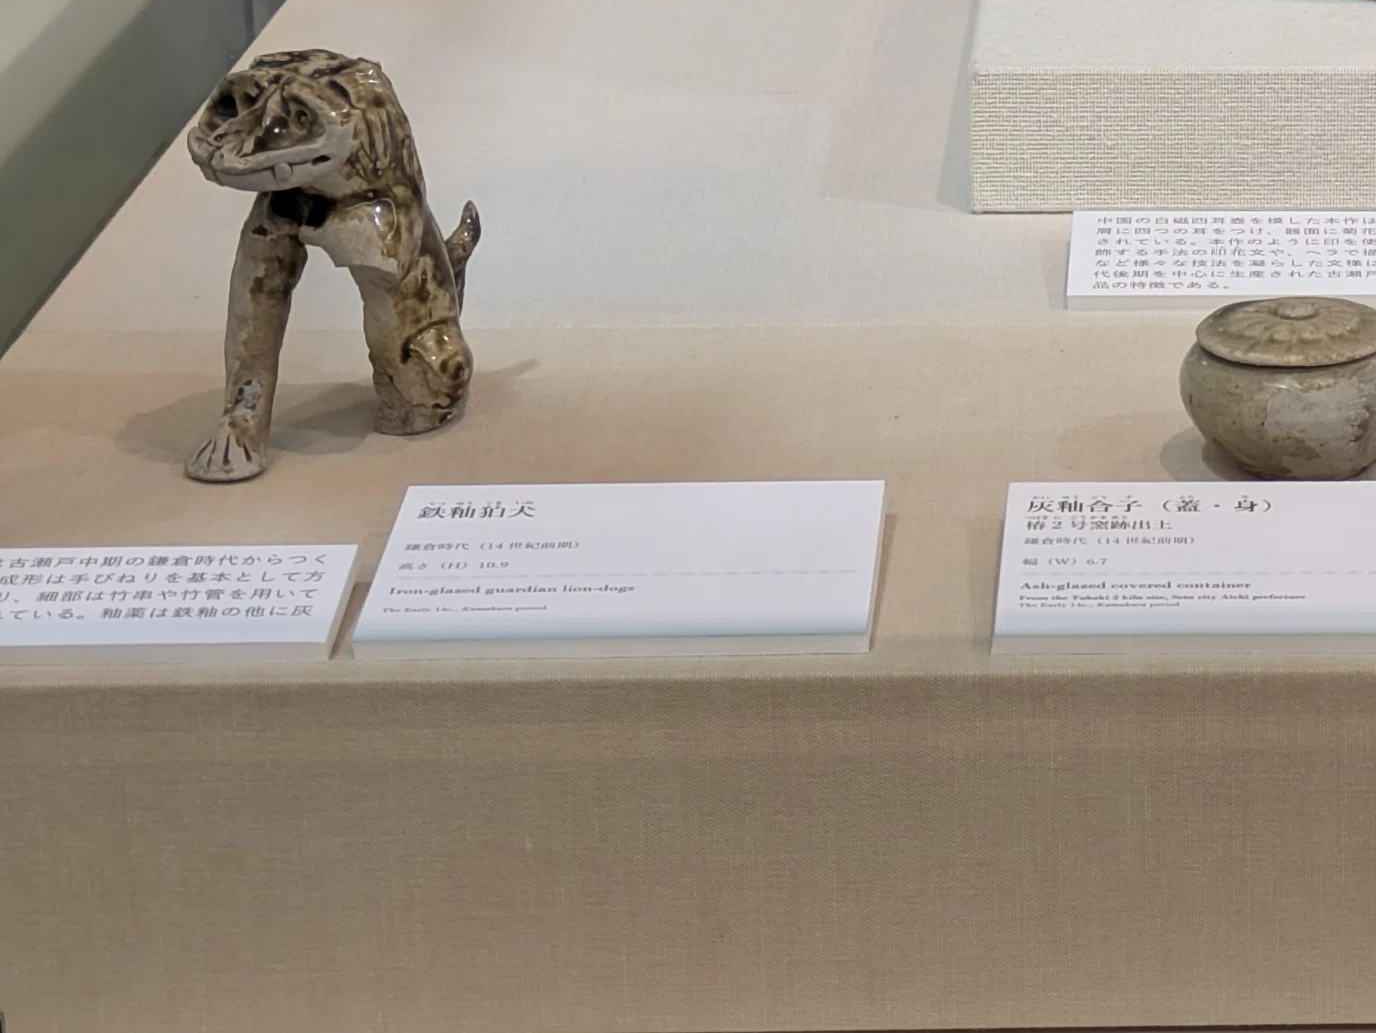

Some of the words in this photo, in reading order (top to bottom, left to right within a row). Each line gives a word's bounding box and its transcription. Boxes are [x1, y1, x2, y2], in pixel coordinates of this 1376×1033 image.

[0, 554, 327, 568] 古瀬戸中期の鎌倉時代からつく
[390, 587, 481, 596] Iron-glazed
[485, 586, 557, 594] guardian
[562, 584, 636, 594] lion-dogs
[1021, 582, 1105, 590] Ash-glazed
[1111, 581, 1172, 589] covered
[0, 605, 313, 620] ている。釉薬は鉄釉の他に灰
